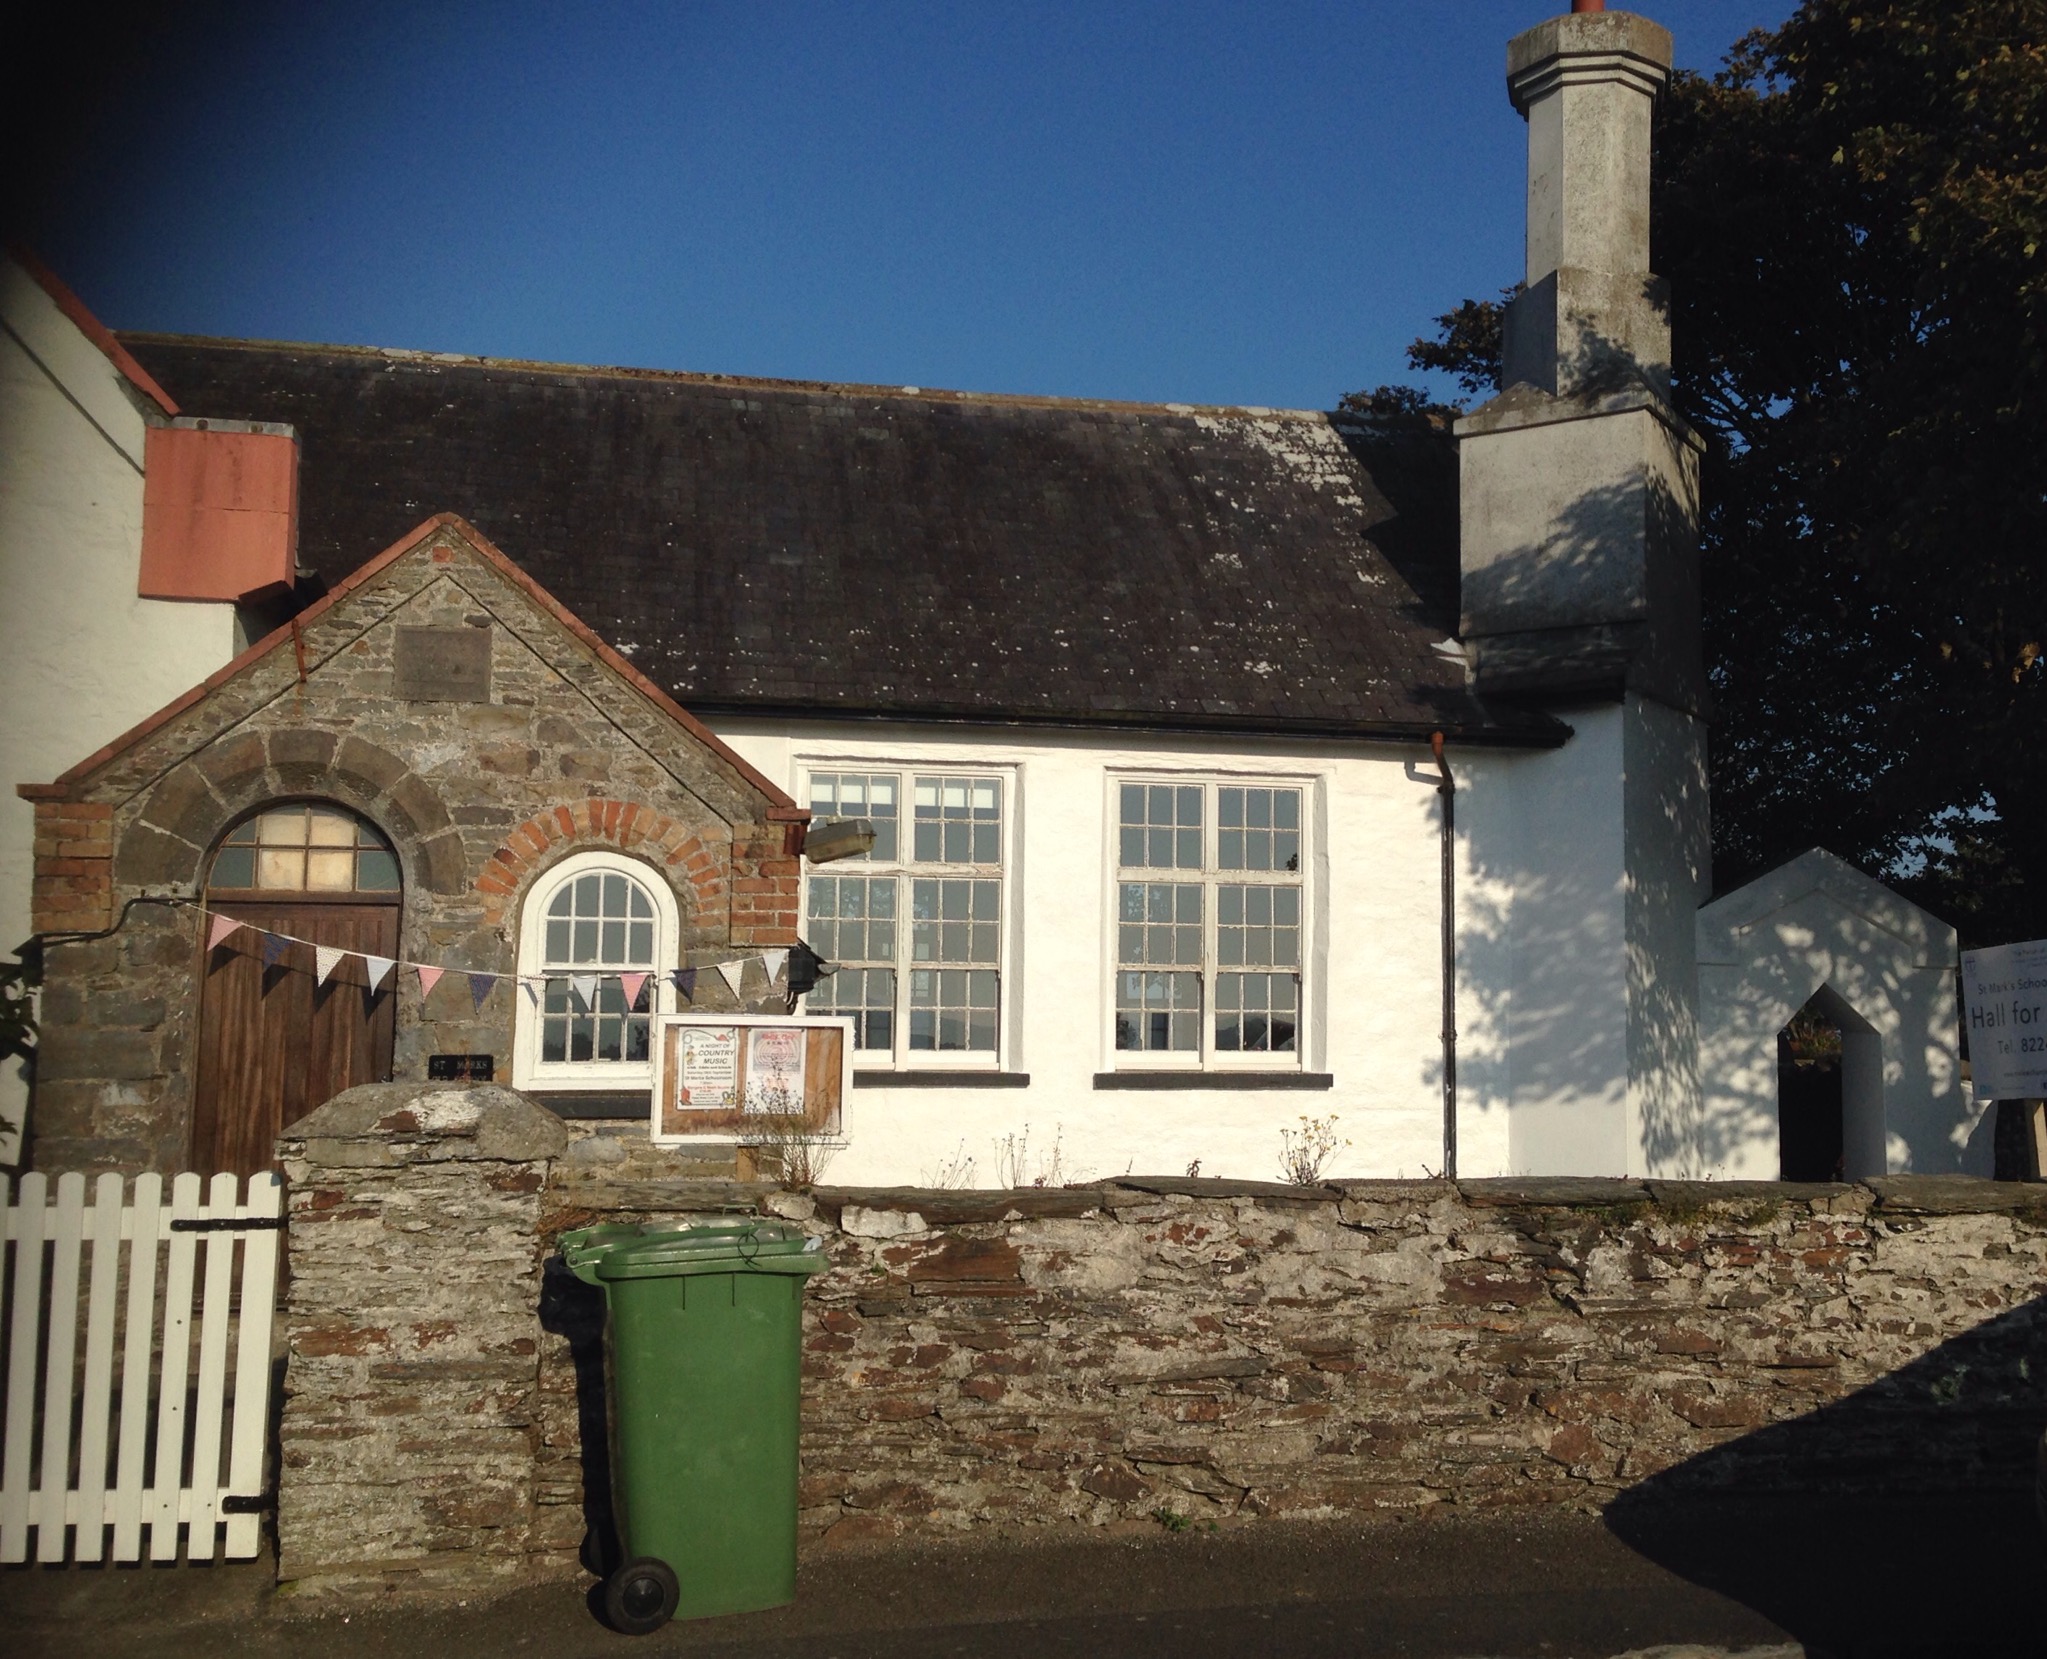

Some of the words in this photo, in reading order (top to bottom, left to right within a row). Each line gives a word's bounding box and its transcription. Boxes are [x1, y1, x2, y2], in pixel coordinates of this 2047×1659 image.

[1978, 983, 1987, 995] St
[1989, 980, 2016, 993] Mark's
[1972, 1002, 2006, 1029] Hall
[2012, 1000, 2040, 1025] for
[2021, 1036, 2047, 1053] 822
[433, 1060, 446, 1070] ST
